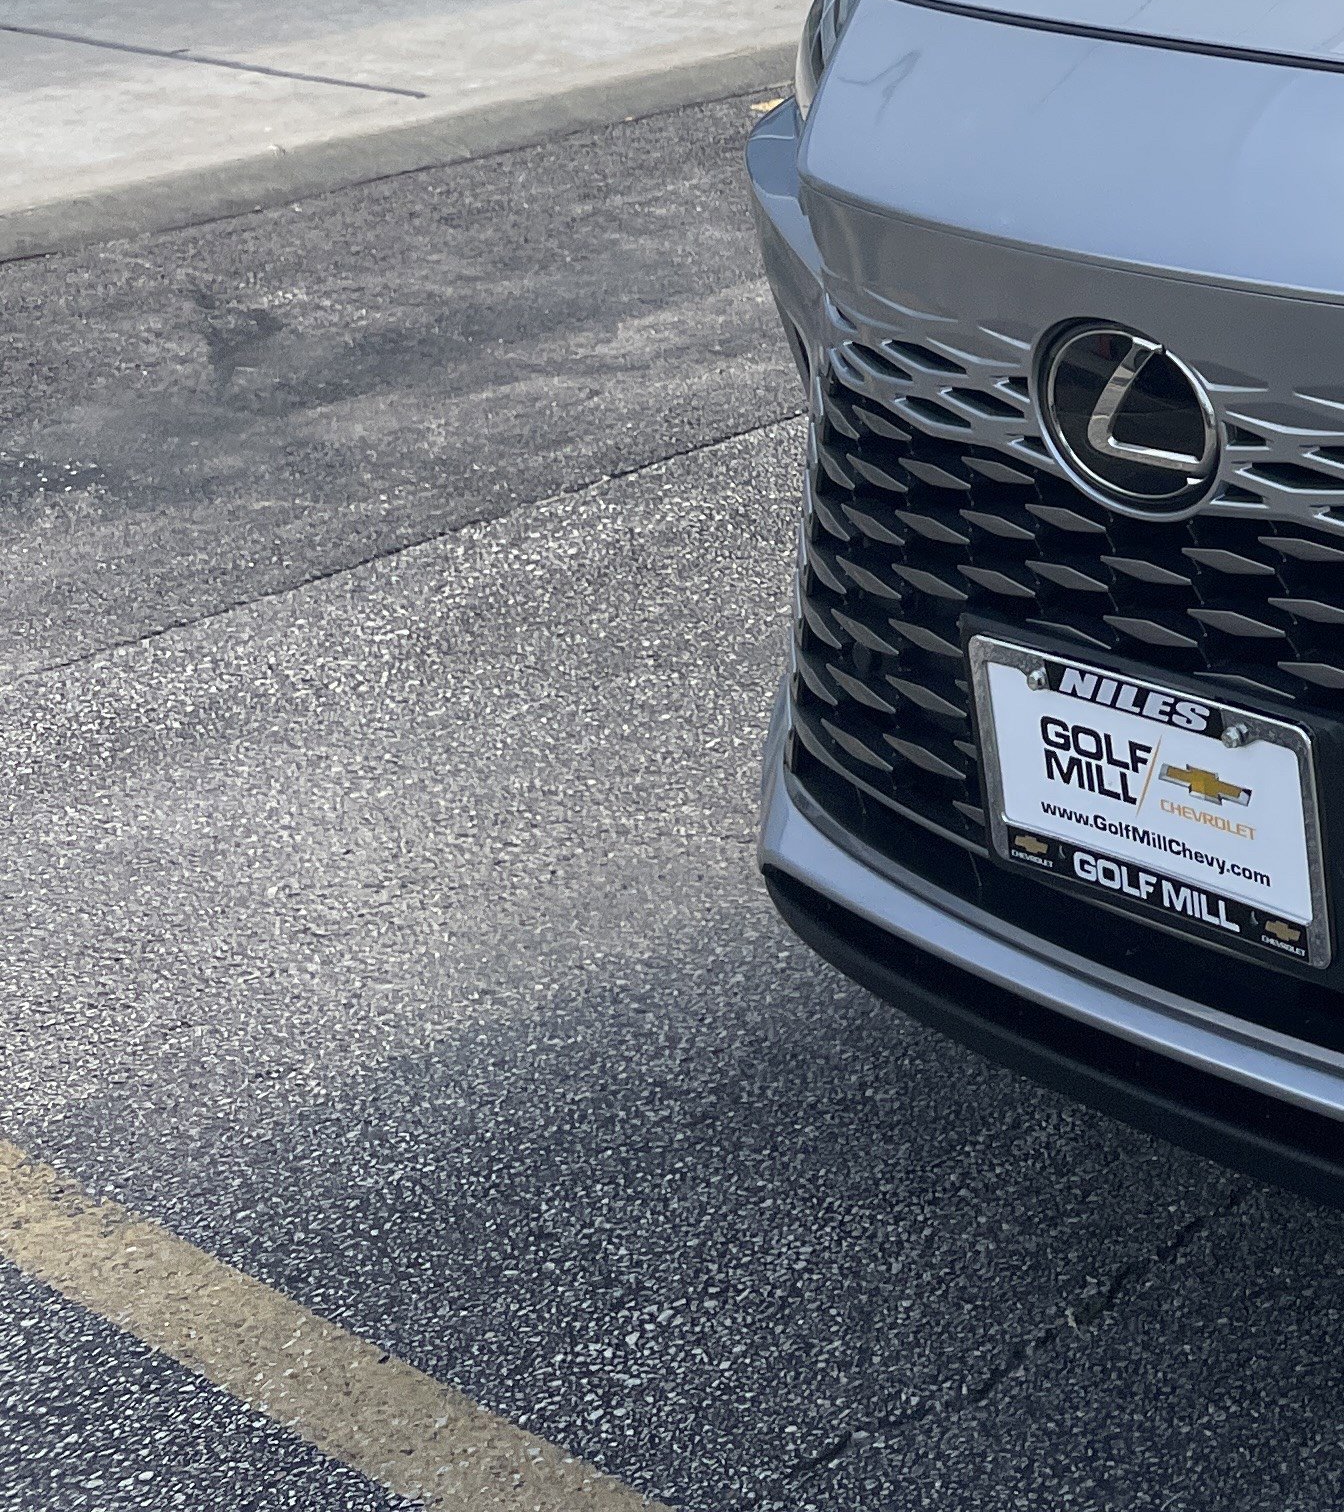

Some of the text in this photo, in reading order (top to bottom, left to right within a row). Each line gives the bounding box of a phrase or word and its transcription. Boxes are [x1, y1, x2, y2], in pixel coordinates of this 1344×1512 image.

[1058, 668, 1211, 733] NILES
[1039, 715, 1153, 774] GOLF
[1044, 749, 1139, 806] MILL
[1040, 800, 1272, 888] www.GolfMillChevy.com
[1160, 798, 1256, 841] CHEVROLET
[1073, 850, 1241, 933] GOLF MILL
